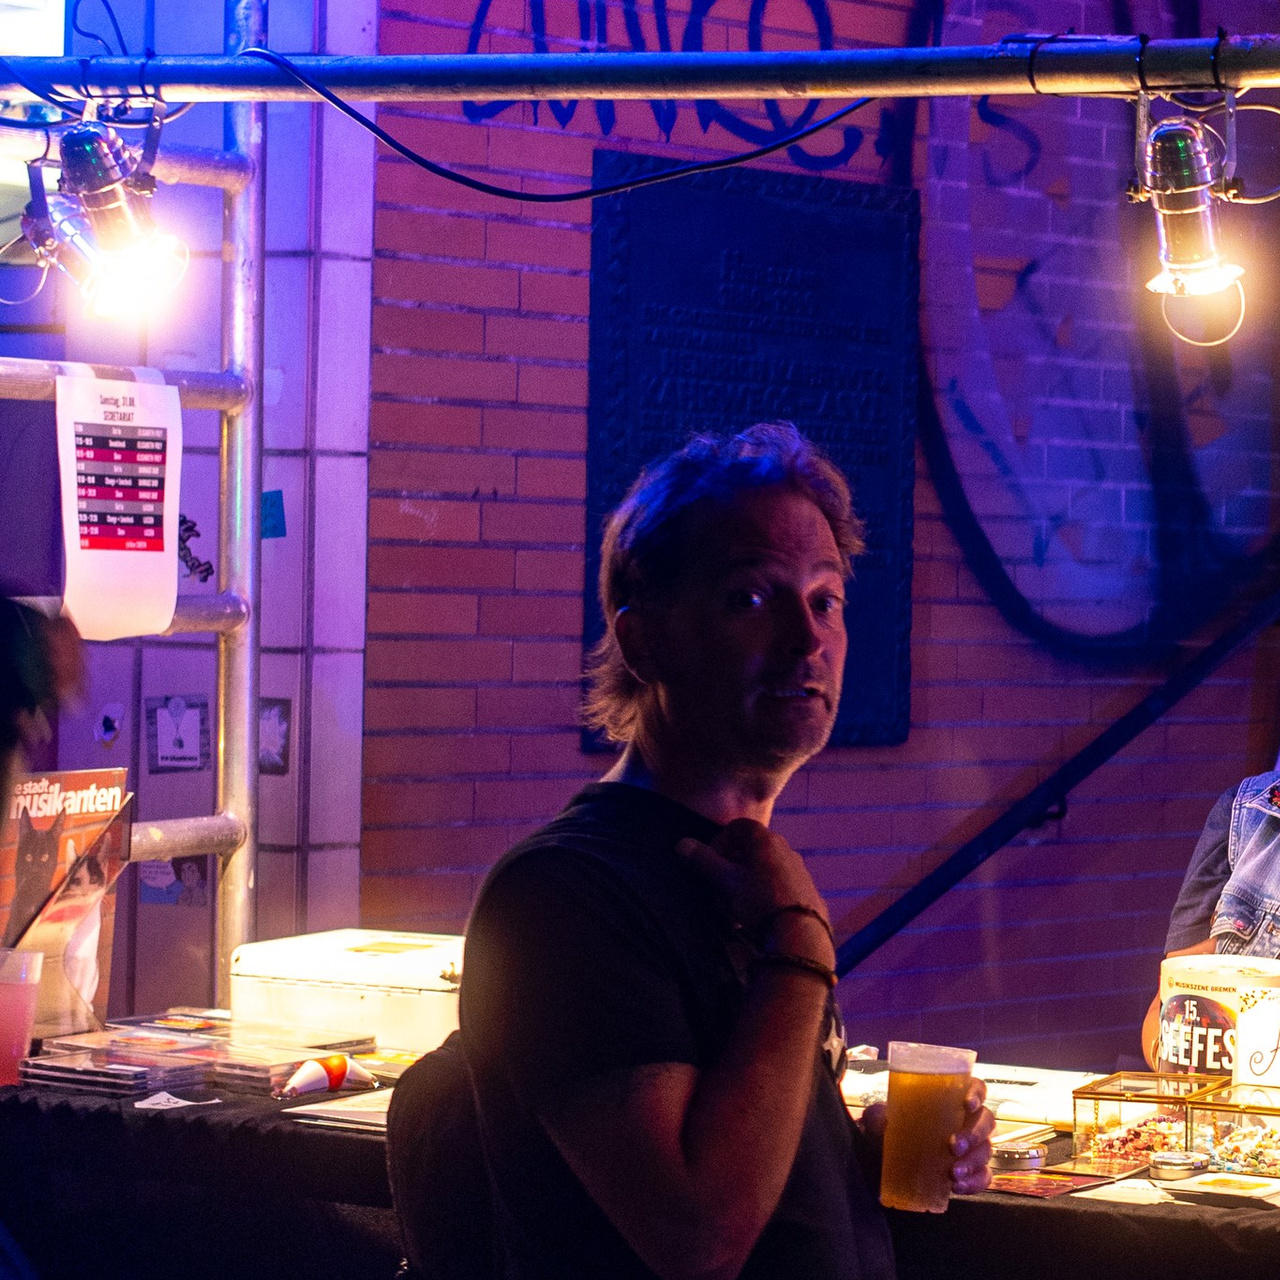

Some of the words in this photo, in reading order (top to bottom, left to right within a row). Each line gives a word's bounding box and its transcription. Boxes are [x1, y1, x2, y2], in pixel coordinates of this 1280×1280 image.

[1175, 981, 1209, 992] MUSIKSZENE
[1211, 985, 1237, 994] BREMEN
[1184, 999, 1201, 1022] 15.
[1160, 1019, 1237, 1070] SEEFES
